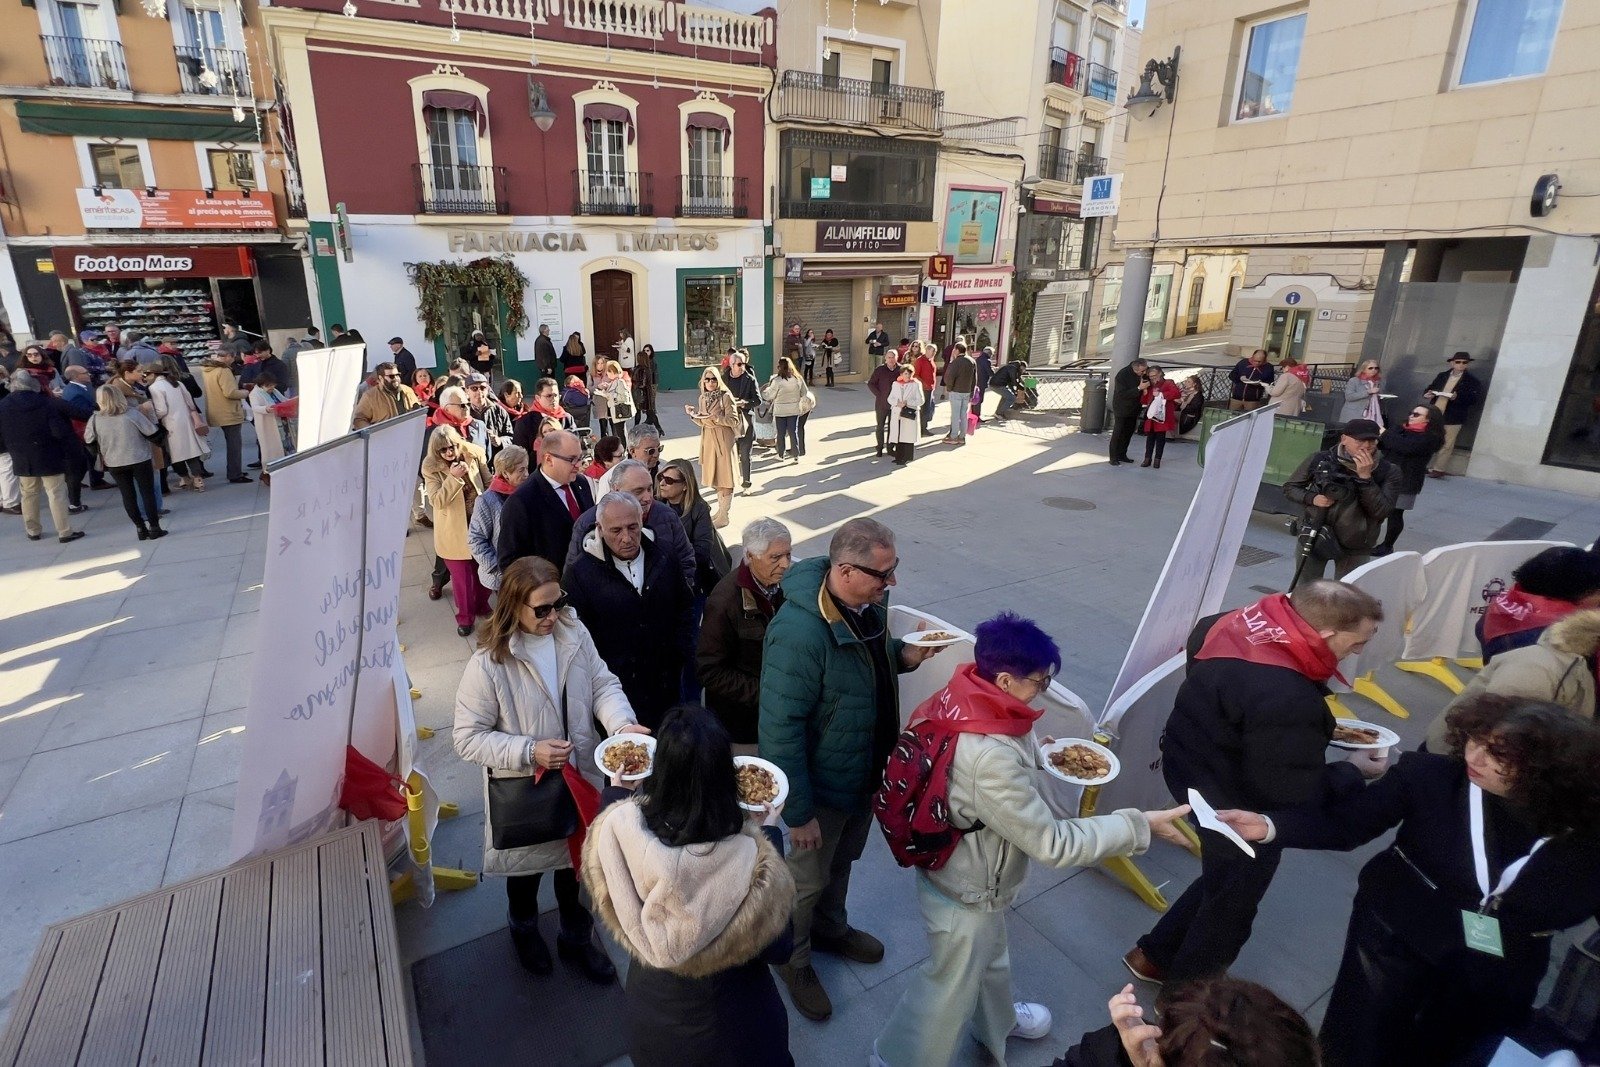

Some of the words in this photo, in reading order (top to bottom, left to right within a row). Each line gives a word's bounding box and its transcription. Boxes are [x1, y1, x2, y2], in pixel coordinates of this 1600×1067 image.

[1094, 180, 1111, 192] AT
[196, 208, 219, 216] precio
[448, 232, 588, 252] FARMACIA
[632, 232, 719, 252] MATEOS
[77, 257, 115, 270] Foot
[121, 258, 142, 270] on
[147, 256, 190, 270] Mars
[974, 278, 1004, 289] ROMERO
